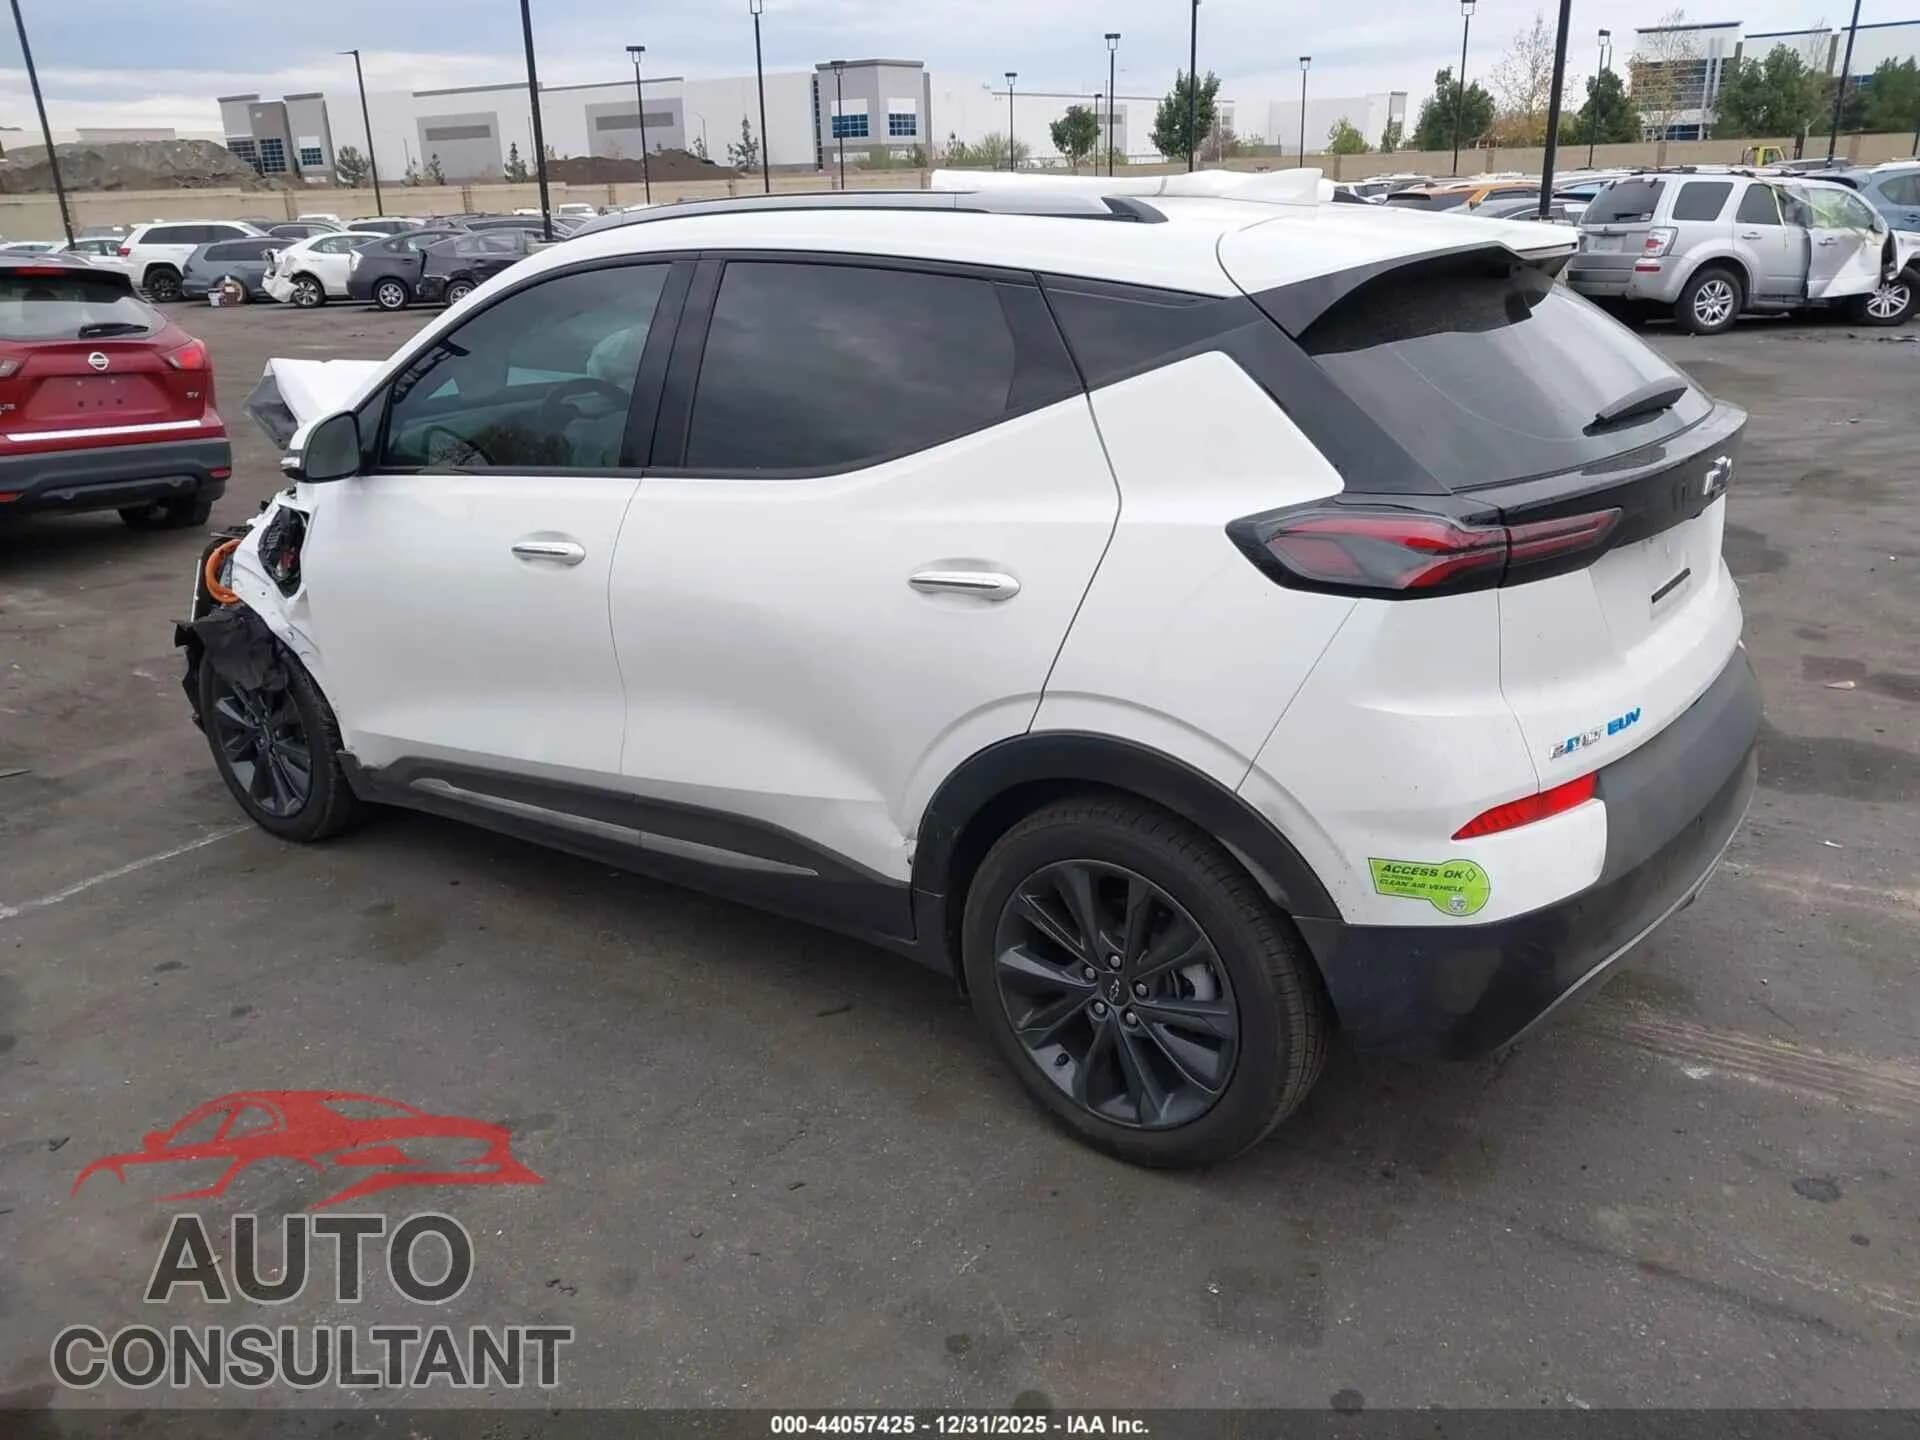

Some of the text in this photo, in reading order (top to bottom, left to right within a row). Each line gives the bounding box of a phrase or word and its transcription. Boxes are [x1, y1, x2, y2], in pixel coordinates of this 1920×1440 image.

[1607, 706, 1641, 736] EUV
[1382, 864, 1439, 877] ACCESS
[1443, 870, 1464, 879] OK
[1379, 879, 1409, 887] CLEAN
[1428, 884, 1464, 893] VEHICLE
